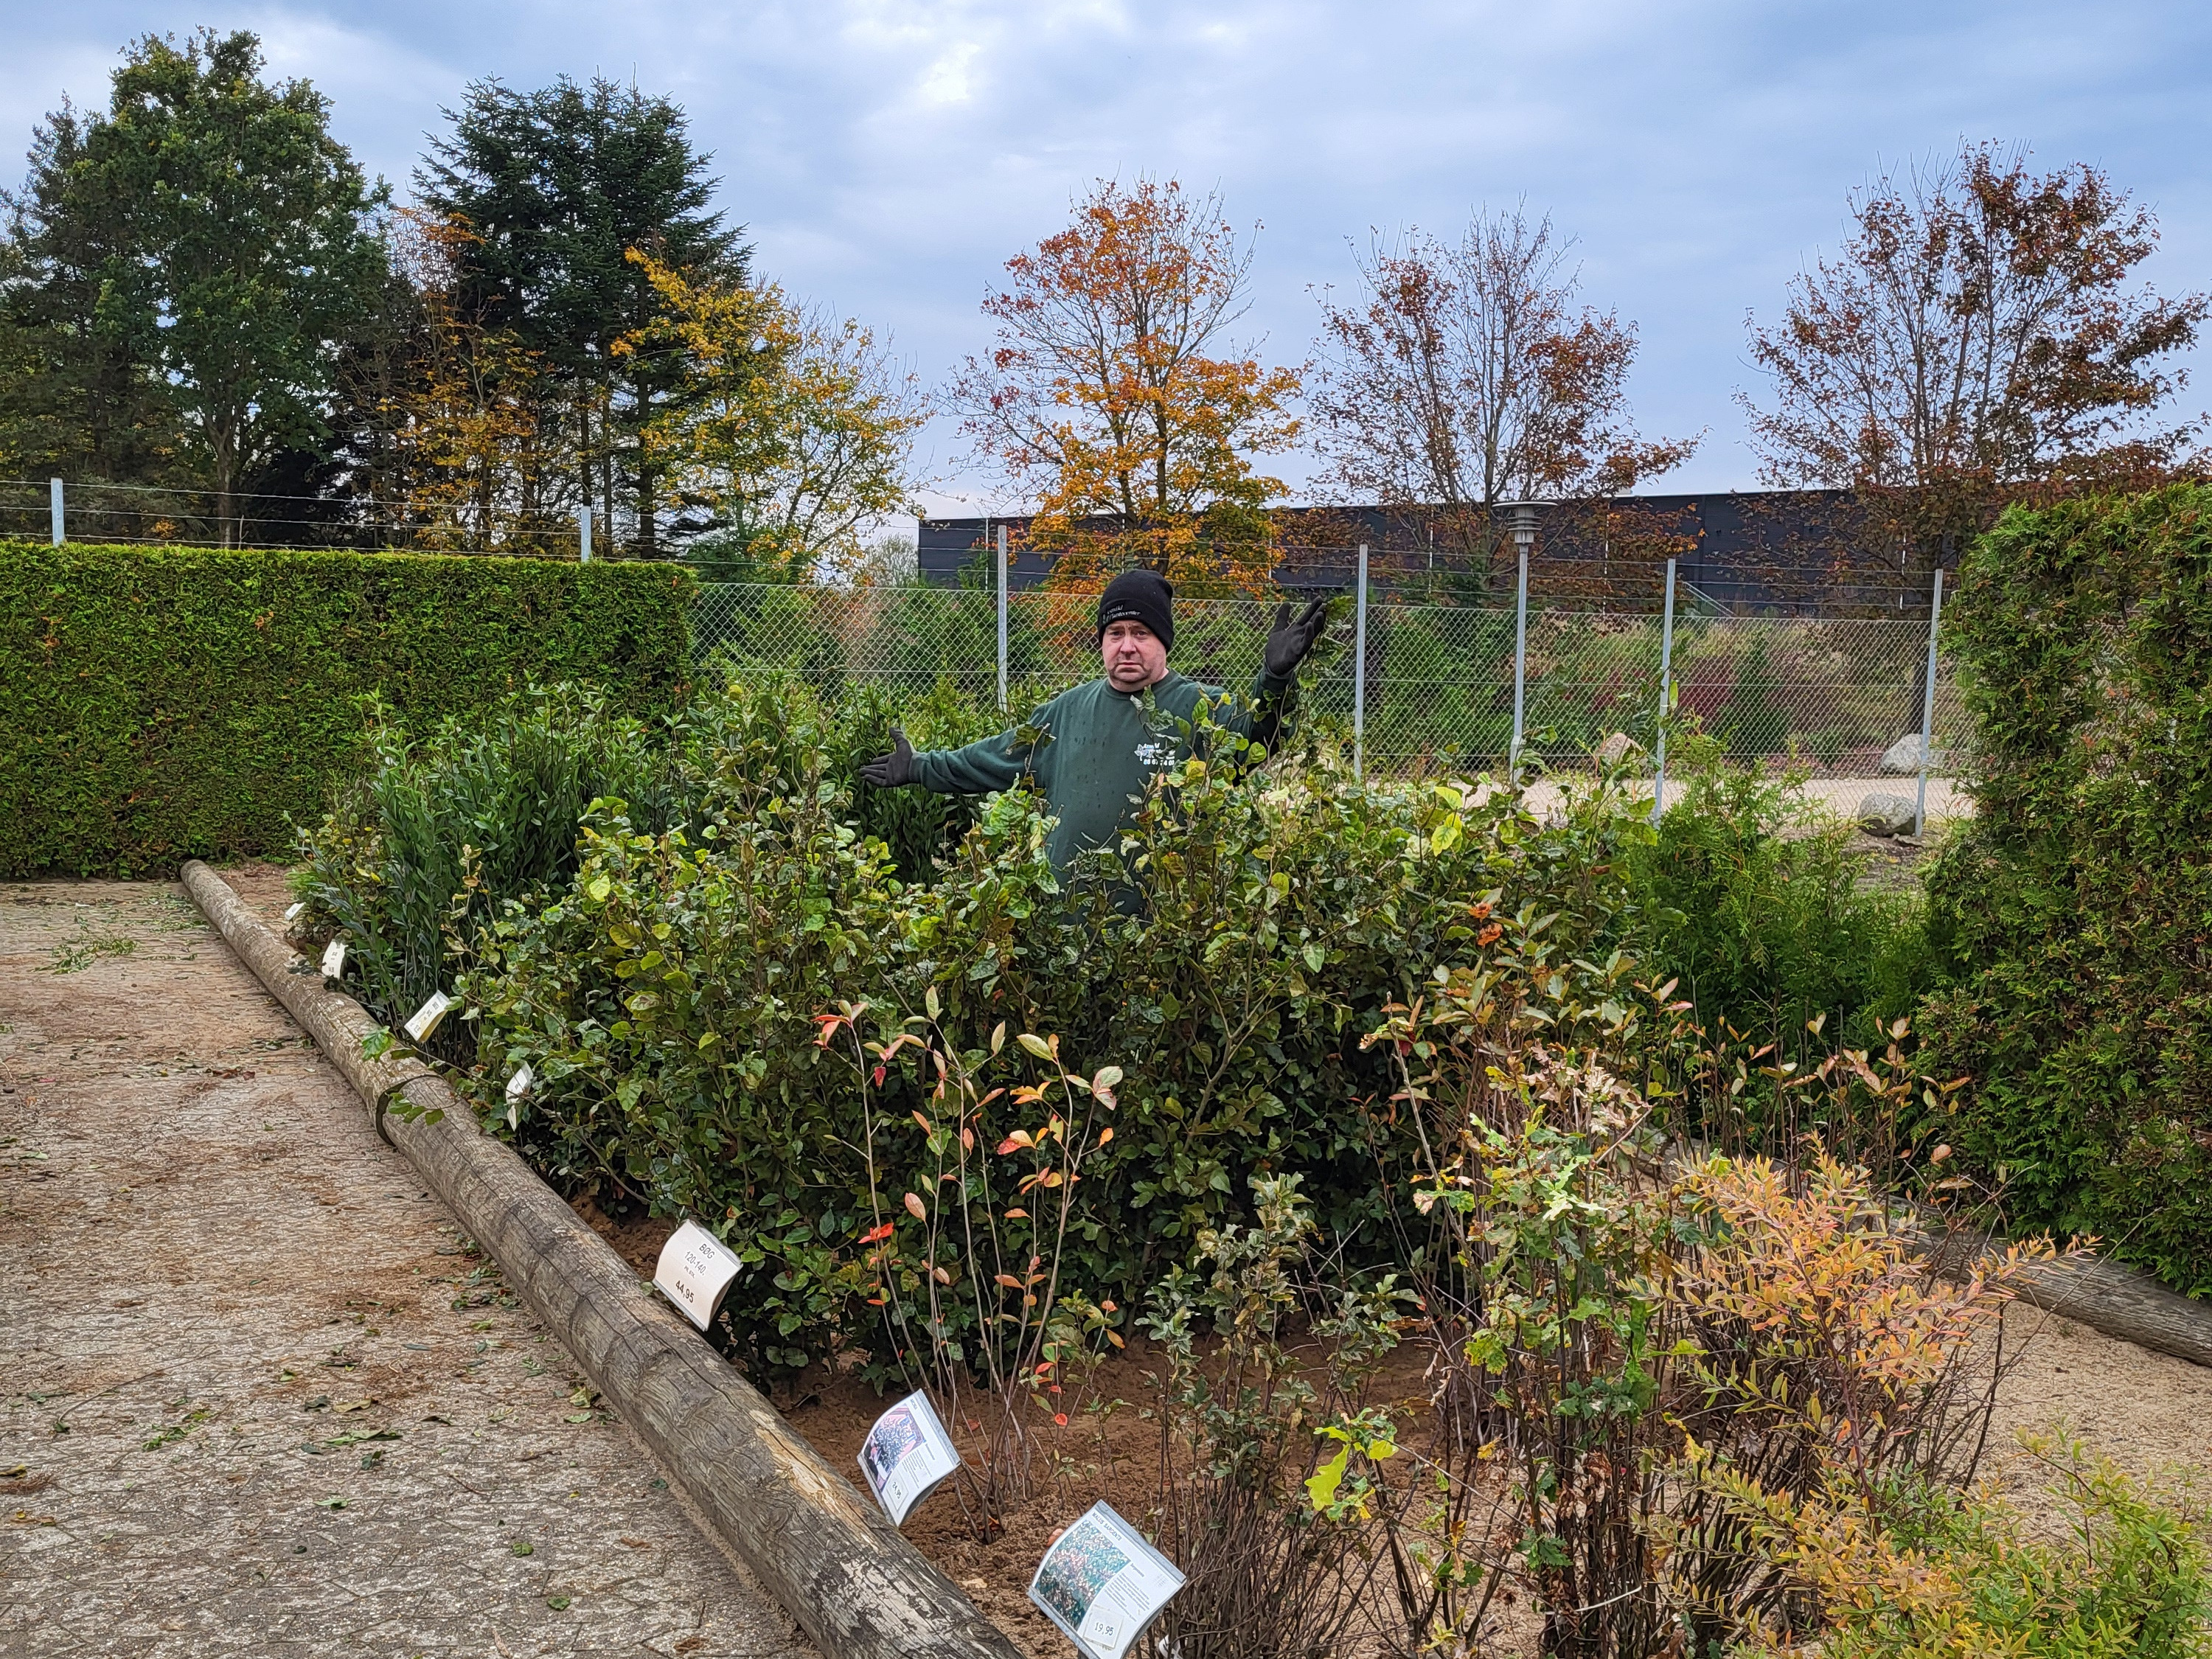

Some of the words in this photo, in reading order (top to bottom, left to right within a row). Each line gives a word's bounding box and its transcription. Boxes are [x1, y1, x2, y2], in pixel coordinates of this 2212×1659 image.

[699, 1243, 715, 1259] BØG
[675, 1280, 695, 1303] 44,95
[1094, 1621, 1114, 1635] 19,95
